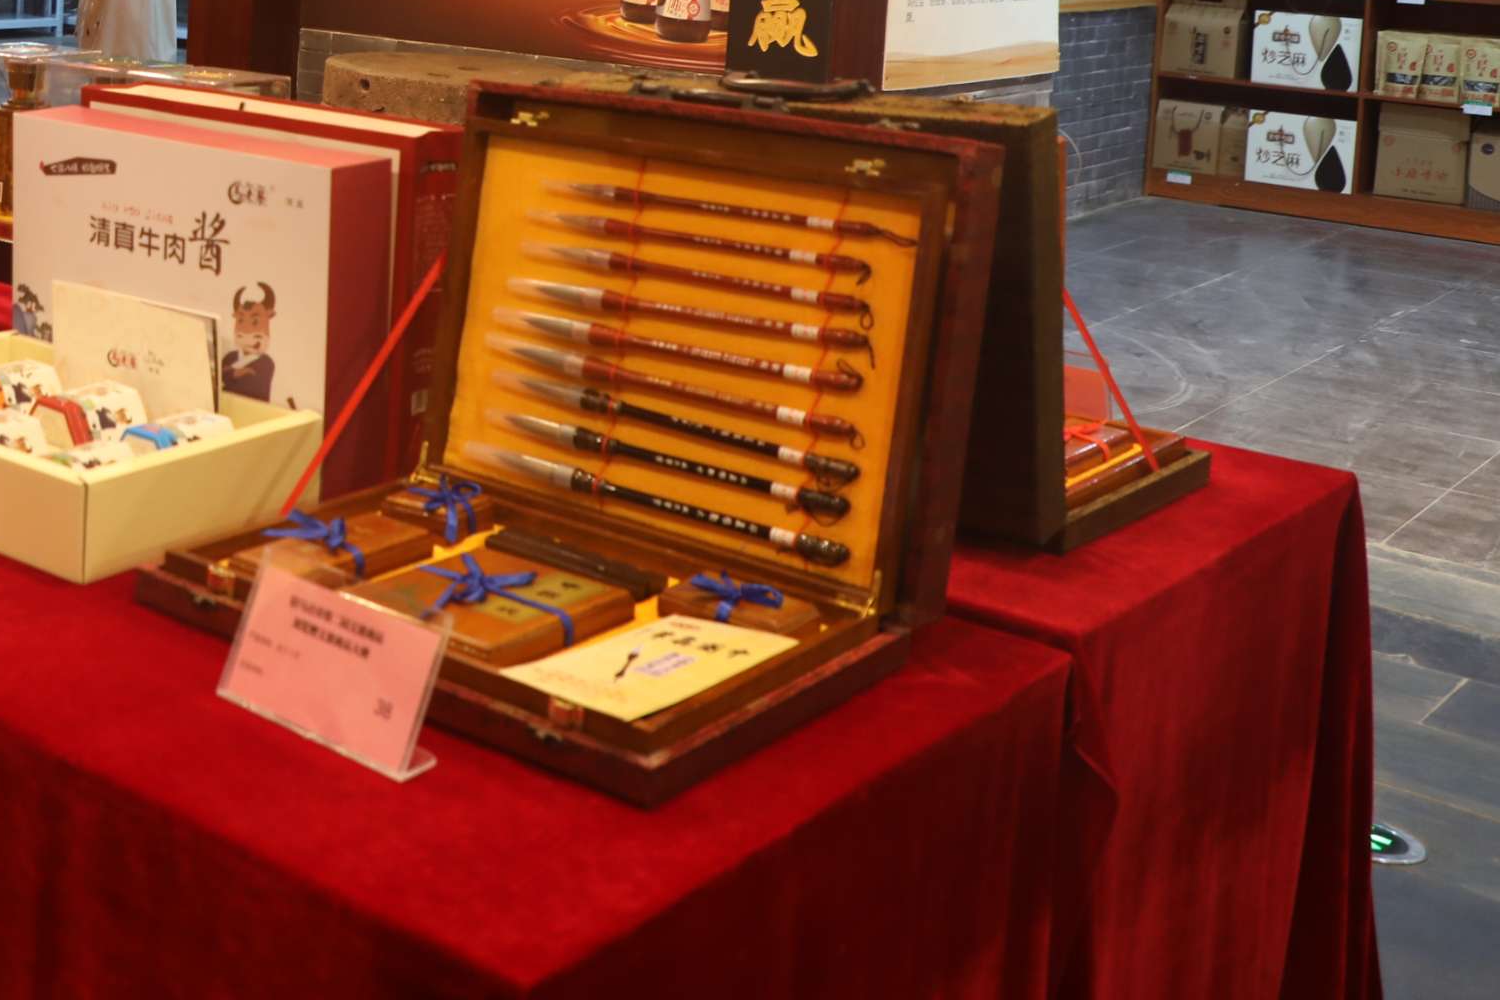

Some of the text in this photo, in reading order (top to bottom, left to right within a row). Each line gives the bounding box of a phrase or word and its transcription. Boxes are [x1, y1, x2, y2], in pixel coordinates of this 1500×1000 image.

[1261, 47, 1307, 68] 炒芝麻
[1255, 148, 1301, 168] 炒芝麻
